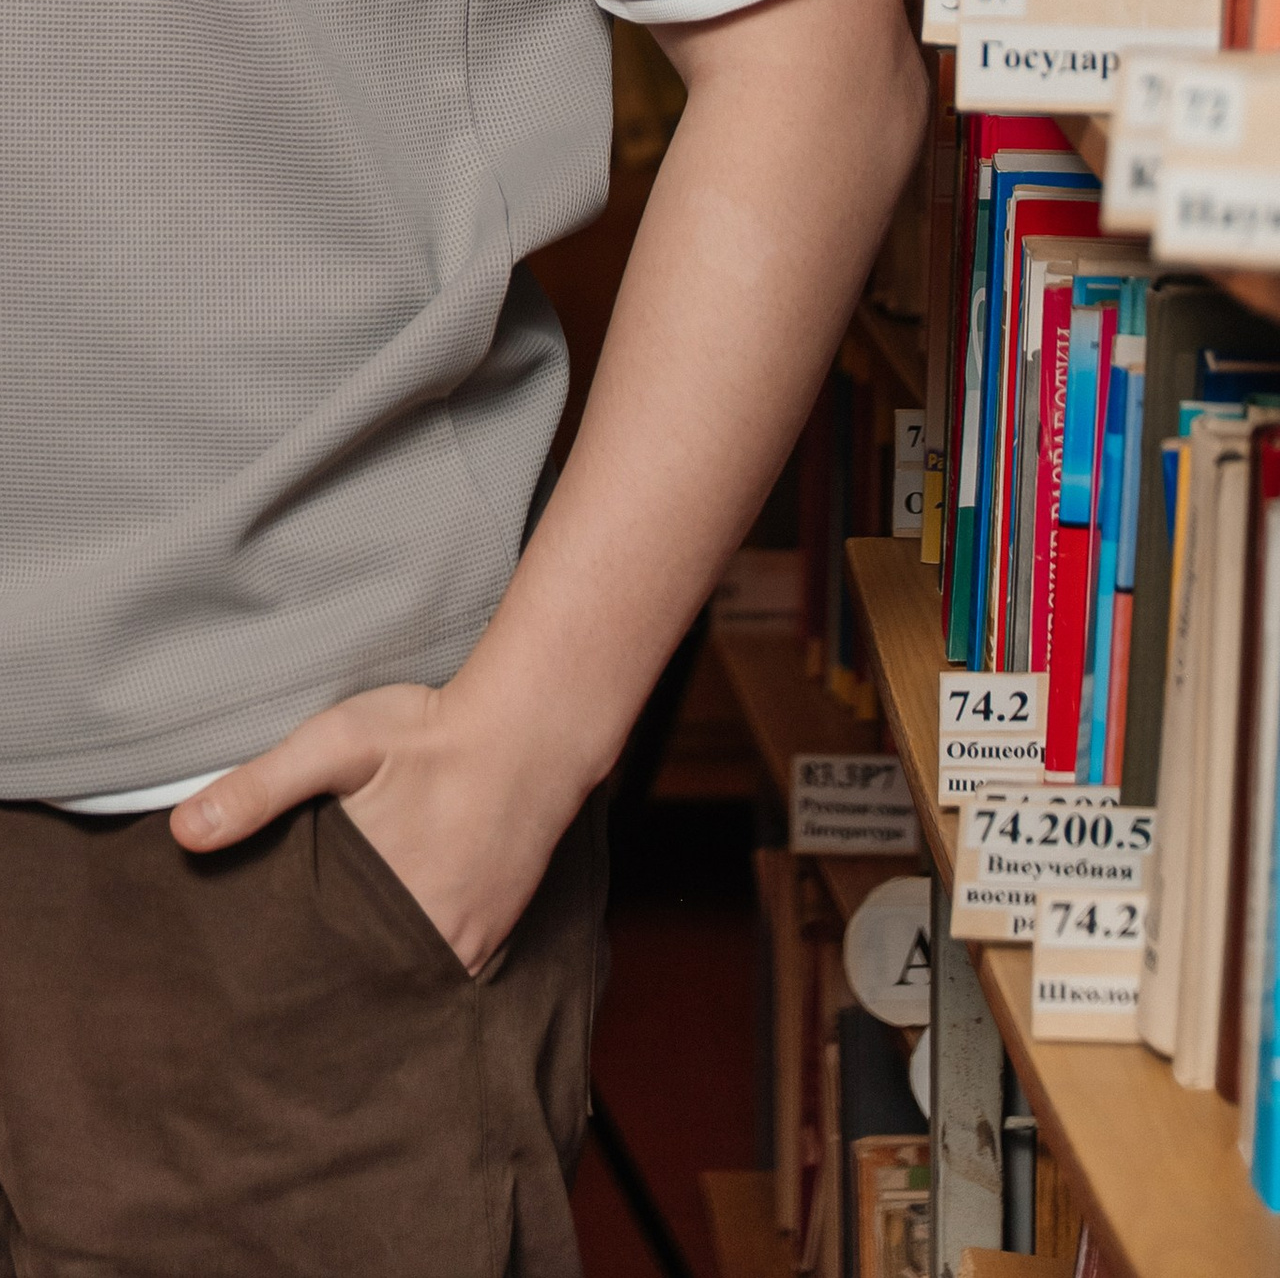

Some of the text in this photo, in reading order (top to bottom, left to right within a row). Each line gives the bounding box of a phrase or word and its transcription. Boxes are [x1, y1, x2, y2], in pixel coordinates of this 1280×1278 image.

[981, 40, 1121, 80] Государ
[948, 689, 1030, 724] 74.2
[974, 809, 1153, 851] 74.200.5
[988, 853, 1133, 882] Внеучебная
[1050, 901, 1139, 939] 74.2
